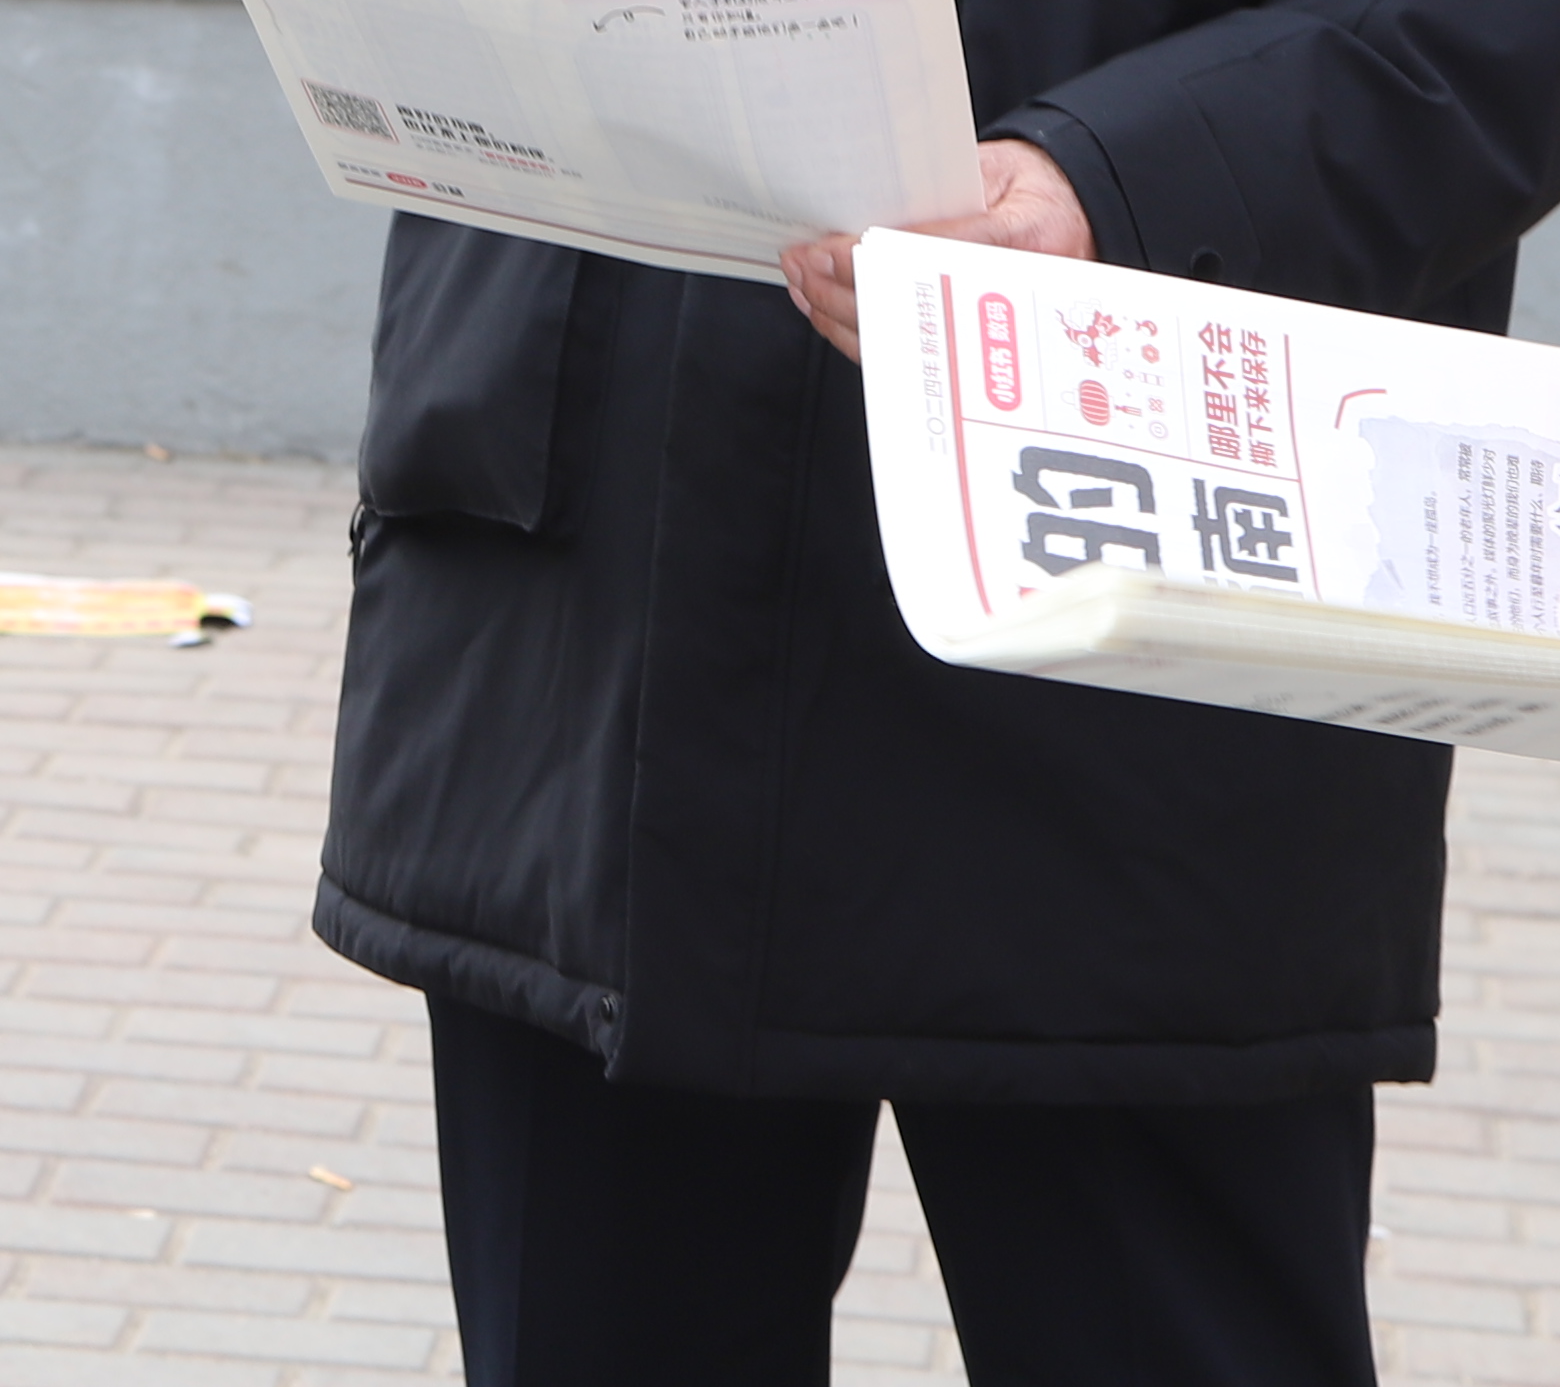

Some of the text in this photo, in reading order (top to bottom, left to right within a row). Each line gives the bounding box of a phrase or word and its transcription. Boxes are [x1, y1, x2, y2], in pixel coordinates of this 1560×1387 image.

[914, 281, 940, 356] 新春特刊
[984, 300, 1016, 404] 小红书 数码
[1198, 321, 1242, 460] 哪里不会
[1240, 329, 1278, 468] 撕下来保存
[1012, 445, 1164, 577] 的
[1191, 477, 1304, 598] 南
